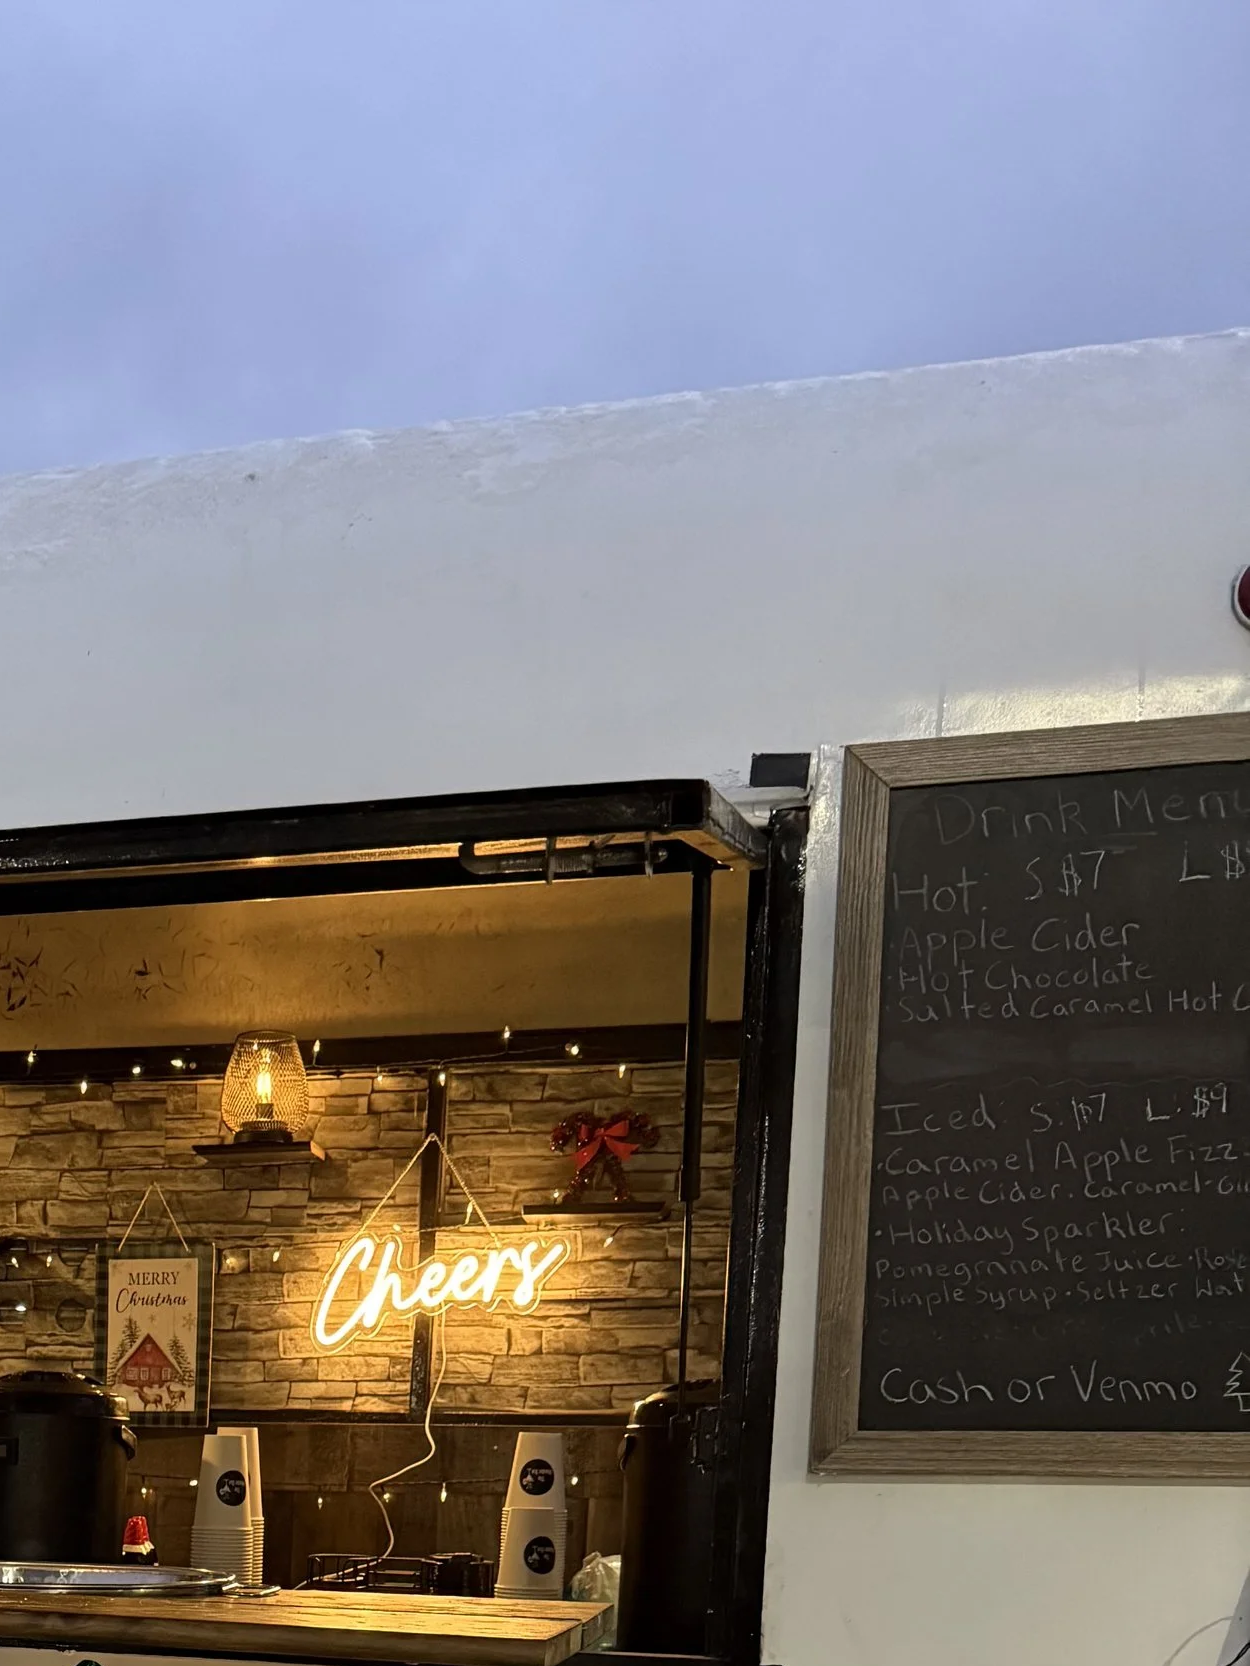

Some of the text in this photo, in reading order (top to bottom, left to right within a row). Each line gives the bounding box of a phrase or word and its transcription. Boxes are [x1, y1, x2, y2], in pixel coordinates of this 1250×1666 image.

[934, 789, 1087, 845] Drink
[1179, 841, 1210, 882] L
[900, 912, 1140, 972] Apple Cider
[900, 954, 1154, 994] Hot Chocolate
[900, 991, 1019, 1022] Salted
[1030, 989, 1153, 1019] Caramel
[1168, 981, 1222, 1012] Hot
[886, 1138, 1034, 1175] Caramel
[1054, 1137, 1150, 1182] Apple
[883, 1180, 970, 1210] Apple
[978, 1179, 1060, 1204] Cider
[1084, 1171, 1200, 1199] Caramel
[891, 1218, 1014, 1256] Holiday
[128, 1271, 180, 1286] MERRY
[1094, 1250, 1182, 1272] Juice
[115, 1287, 189, 1313] Christmas
[315, 1237, 564, 1346] Cheers
[874, 1280, 965, 1316] Simple
[975, 1286, 1057, 1310] Syrup
[1076, 1280, 1178, 1302] Seltzer
[880, 1359, 1197, 1404] Cash or Venmo
